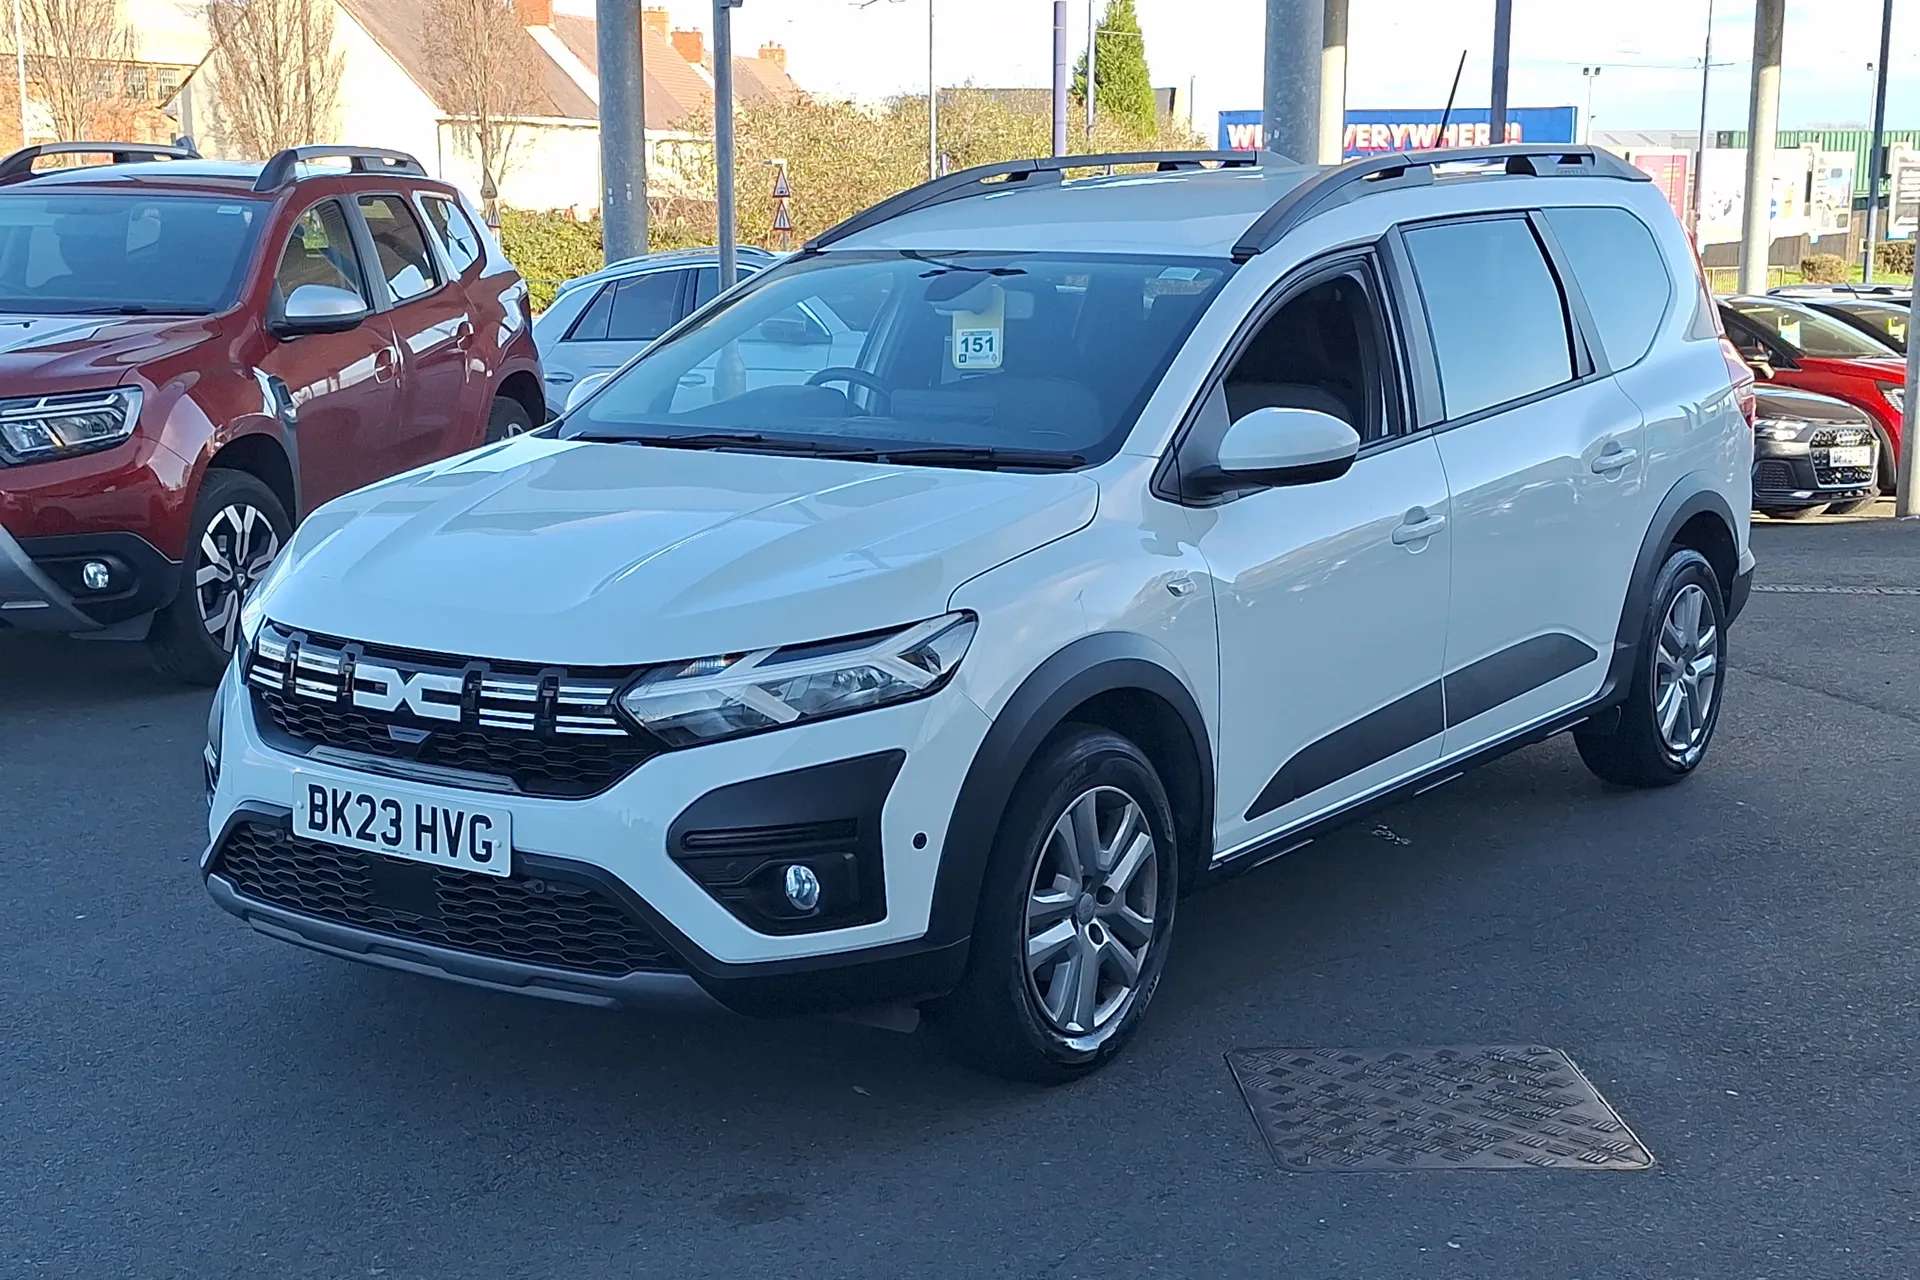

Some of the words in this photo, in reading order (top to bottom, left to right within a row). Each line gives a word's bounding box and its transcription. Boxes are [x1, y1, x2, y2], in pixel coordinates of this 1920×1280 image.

[961, 336, 994, 353] 151
[308, 783, 402, 847] BK23
[415, 804, 493, 863] HVG
